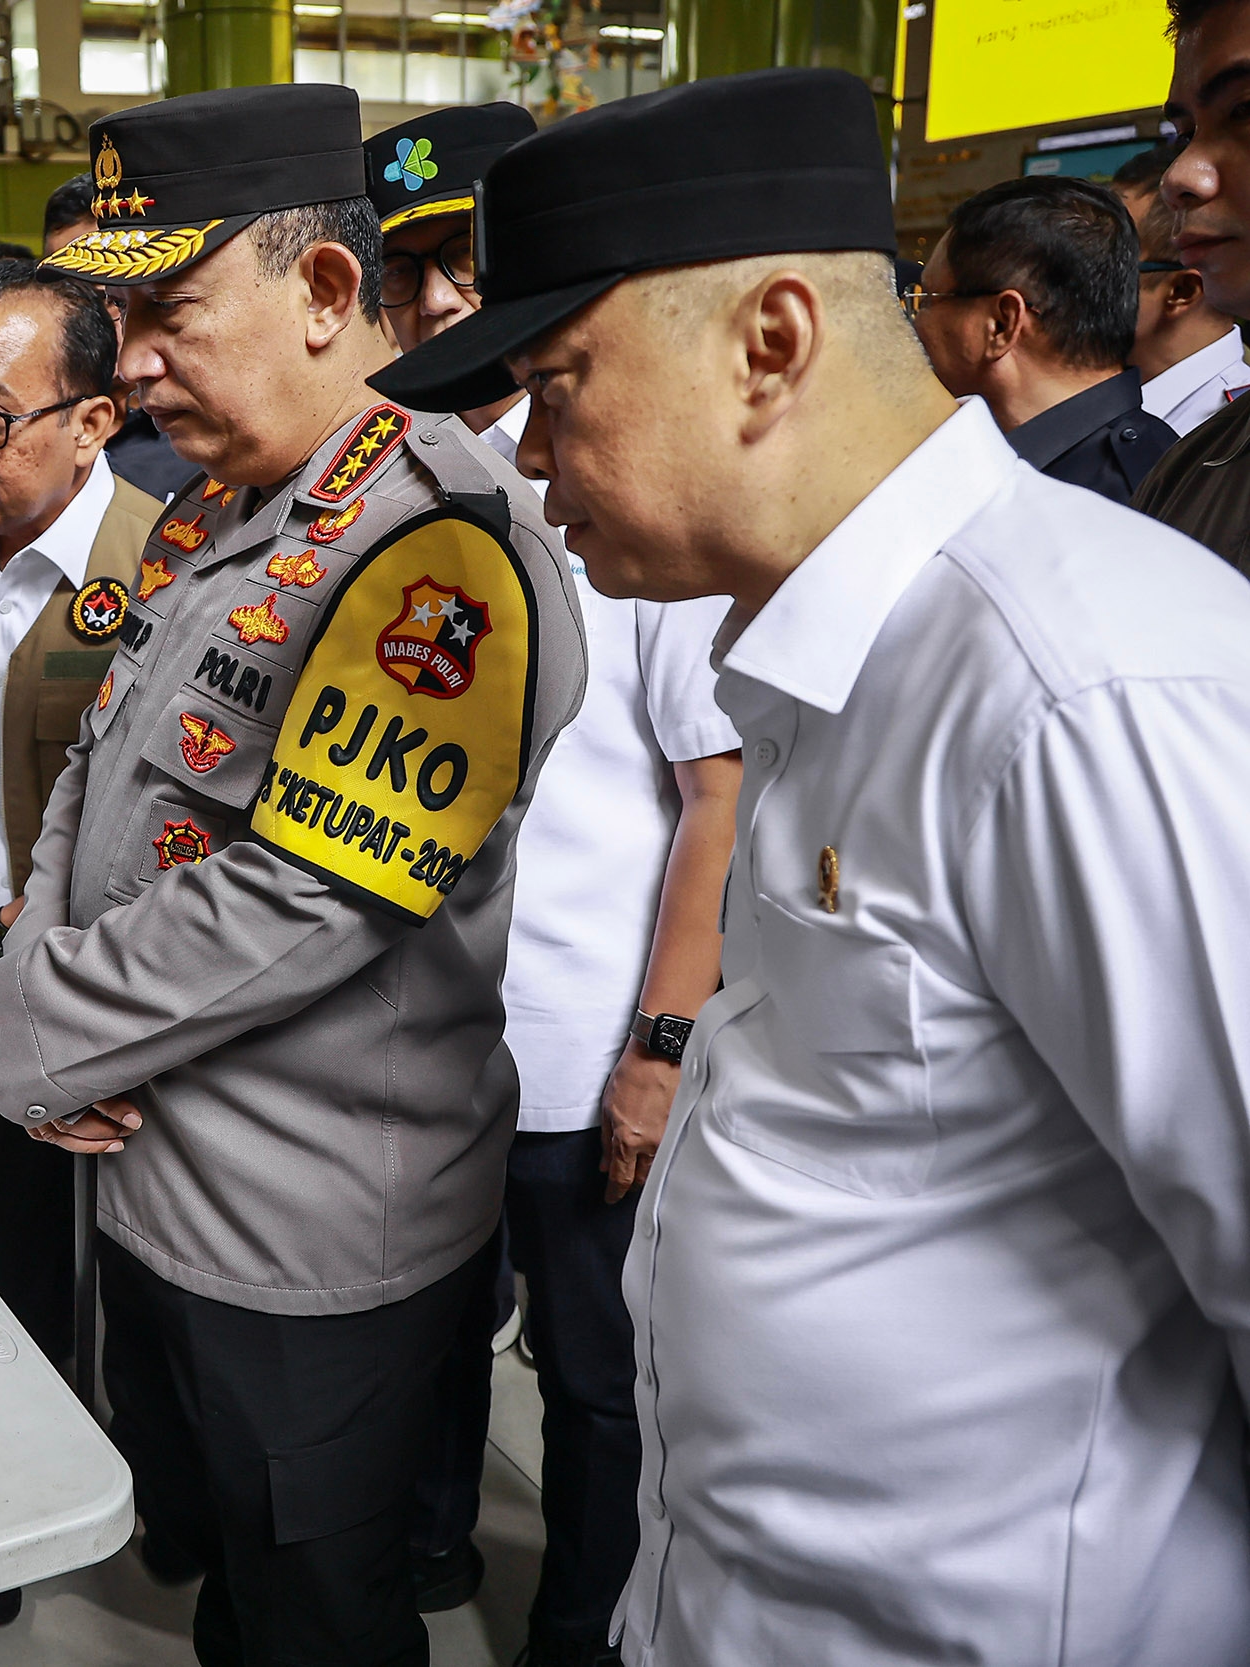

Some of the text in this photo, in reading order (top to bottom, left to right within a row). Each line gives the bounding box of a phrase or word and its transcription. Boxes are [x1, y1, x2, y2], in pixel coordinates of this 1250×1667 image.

[195, 646, 273, 713] POLRI
[383, 641, 465, 689] MABES POLRI
[299, 685, 469, 812] PJKO
